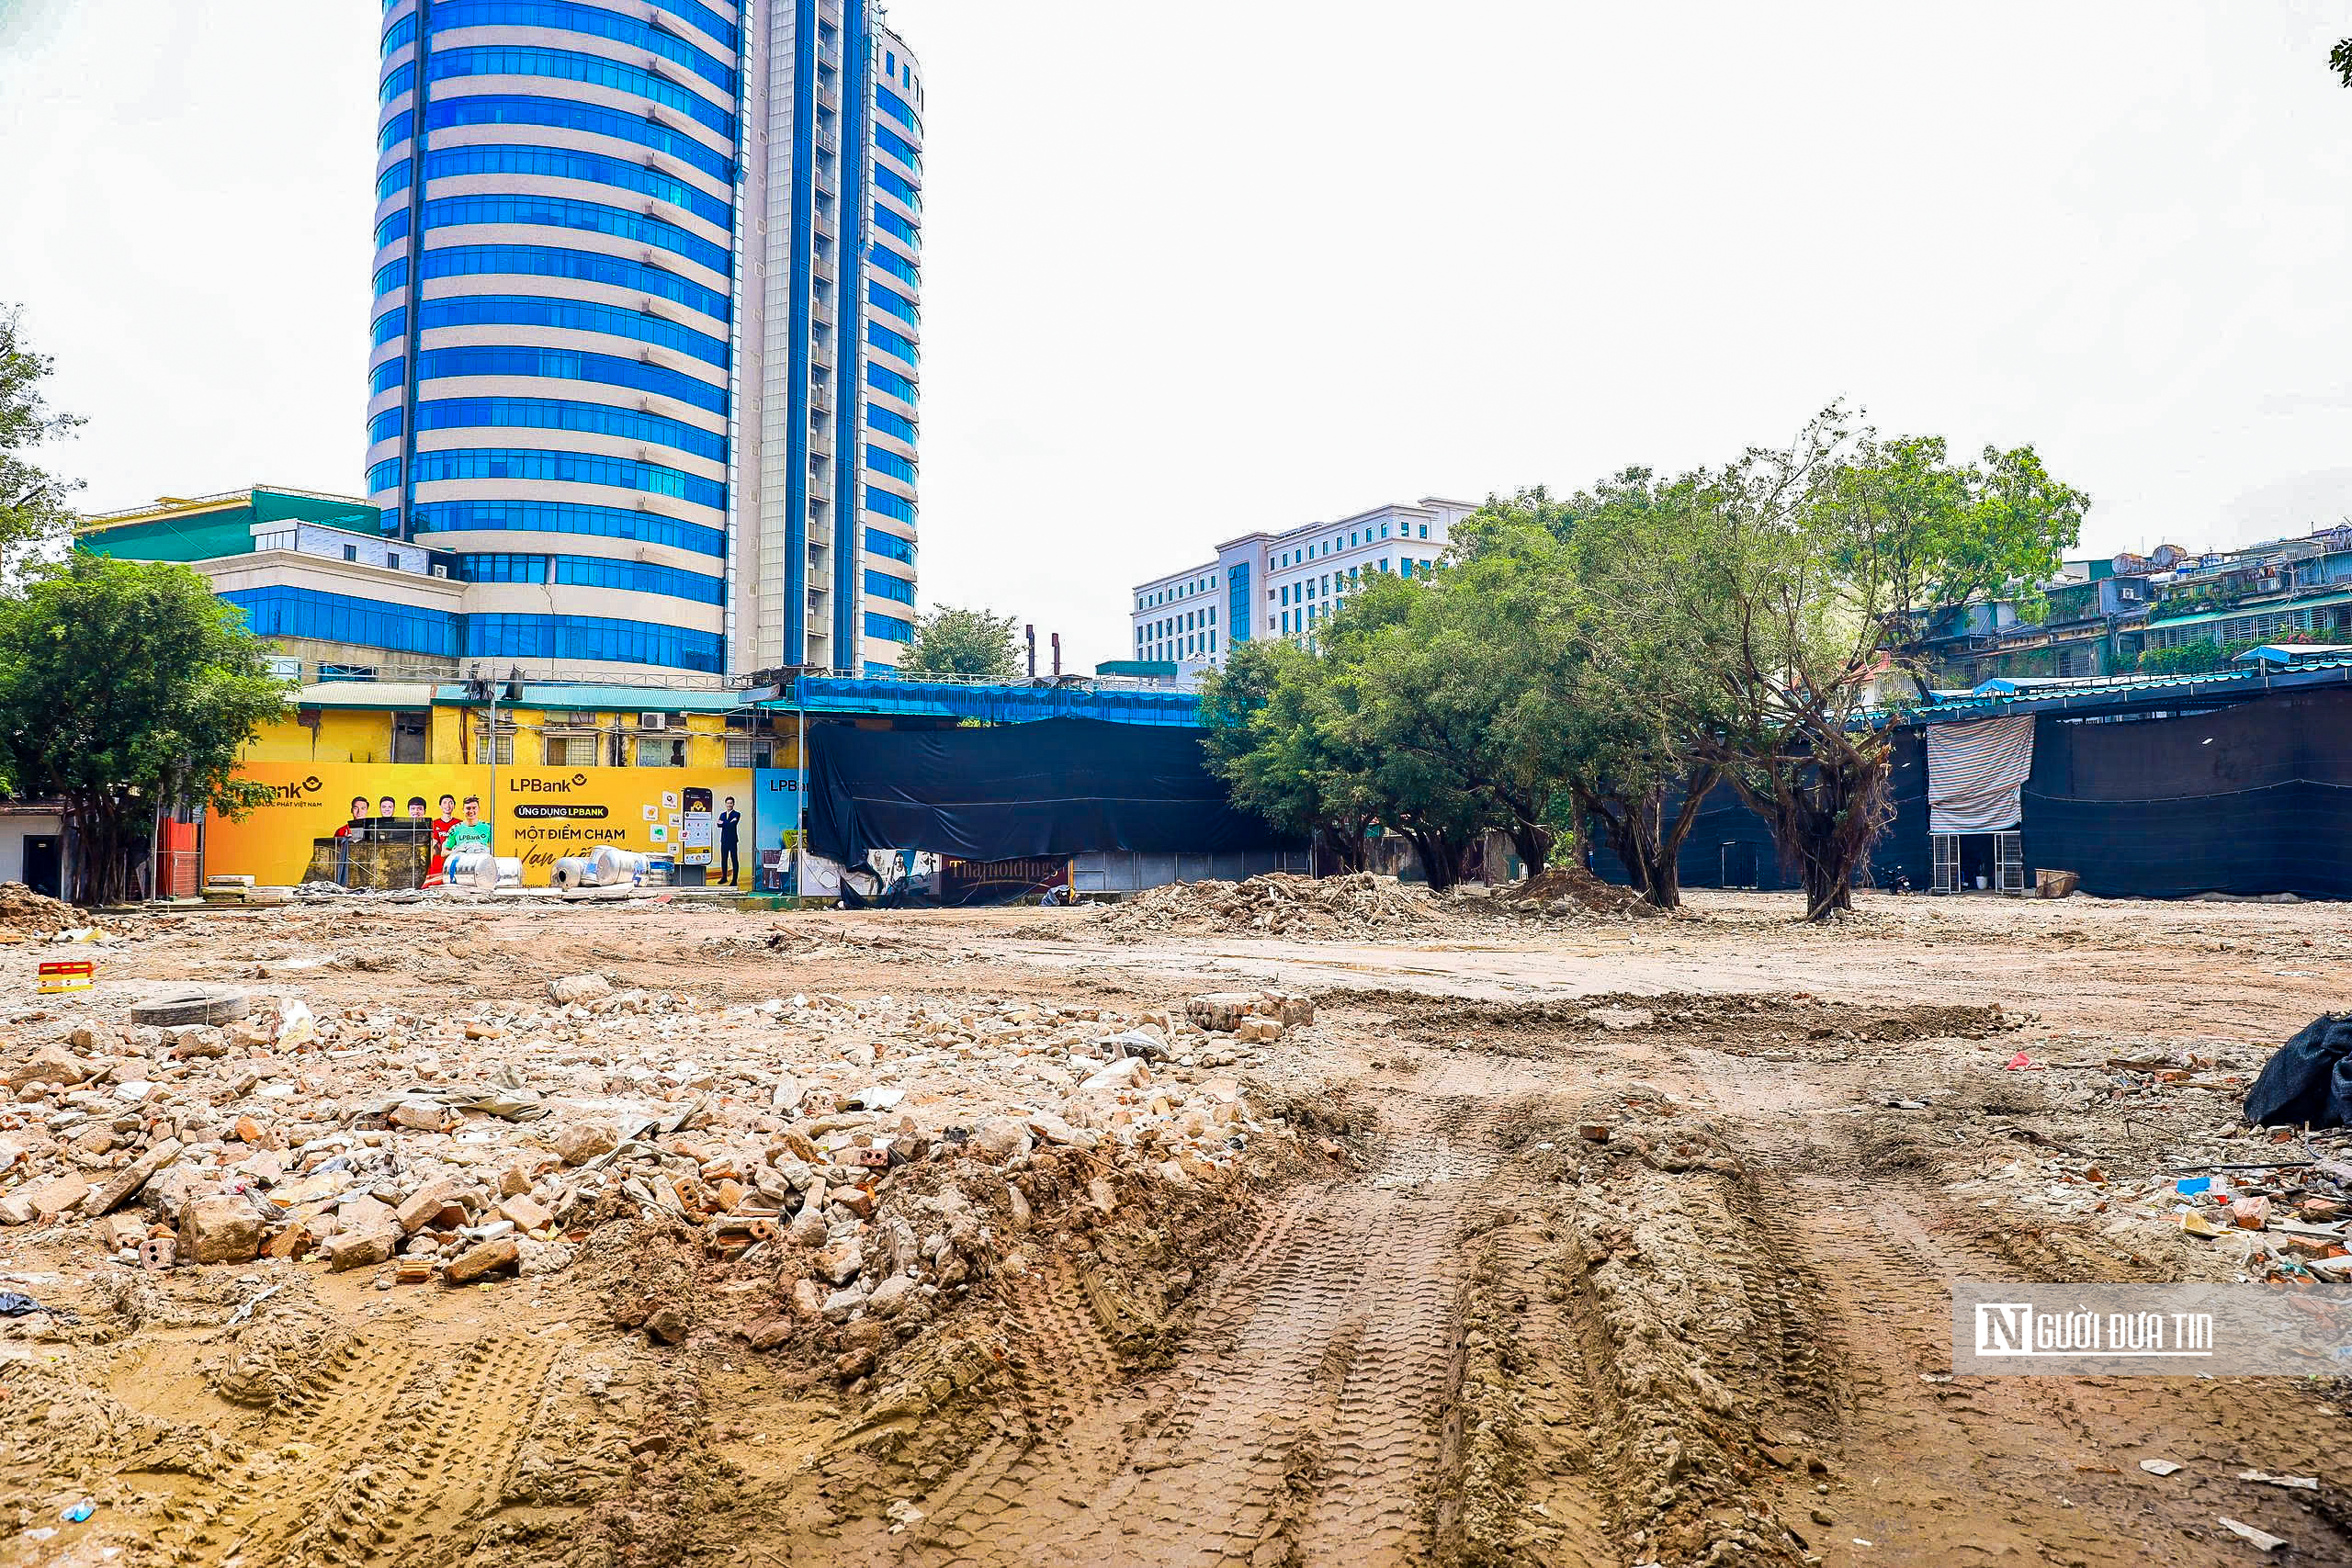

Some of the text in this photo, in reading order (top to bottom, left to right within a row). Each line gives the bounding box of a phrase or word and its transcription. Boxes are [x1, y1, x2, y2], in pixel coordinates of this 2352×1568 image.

[510, 778, 571, 792] LPBank
[518, 806, 604, 818] ỨNG DỤNG LPBANK
[514, 824, 626, 842] MỘT ĐIỂM CHẠM
